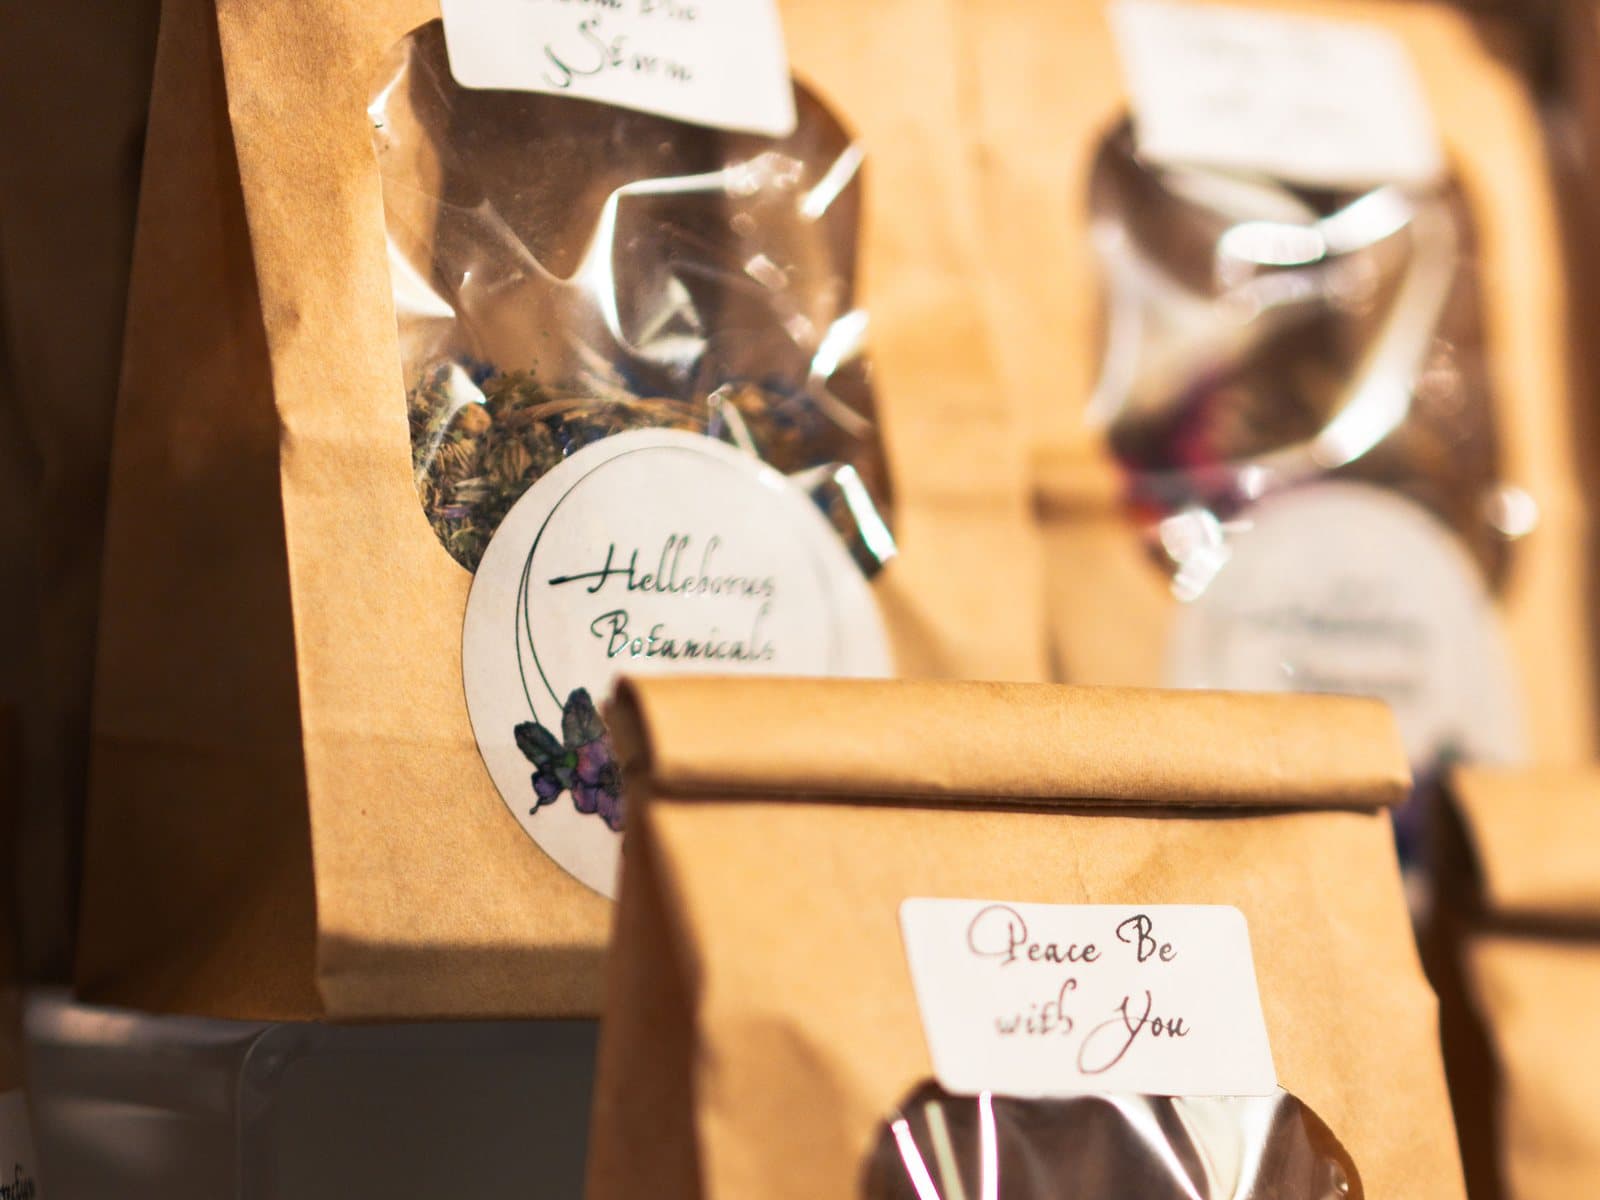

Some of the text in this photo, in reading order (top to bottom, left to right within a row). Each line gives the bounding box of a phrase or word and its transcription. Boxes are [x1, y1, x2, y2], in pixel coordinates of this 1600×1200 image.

[549, 533, 776, 598] Helleborus
[590, 601, 776, 661] Botanicals
[967, 904, 1178, 967] Peace Be
[994, 978, 1190, 1075] with You
